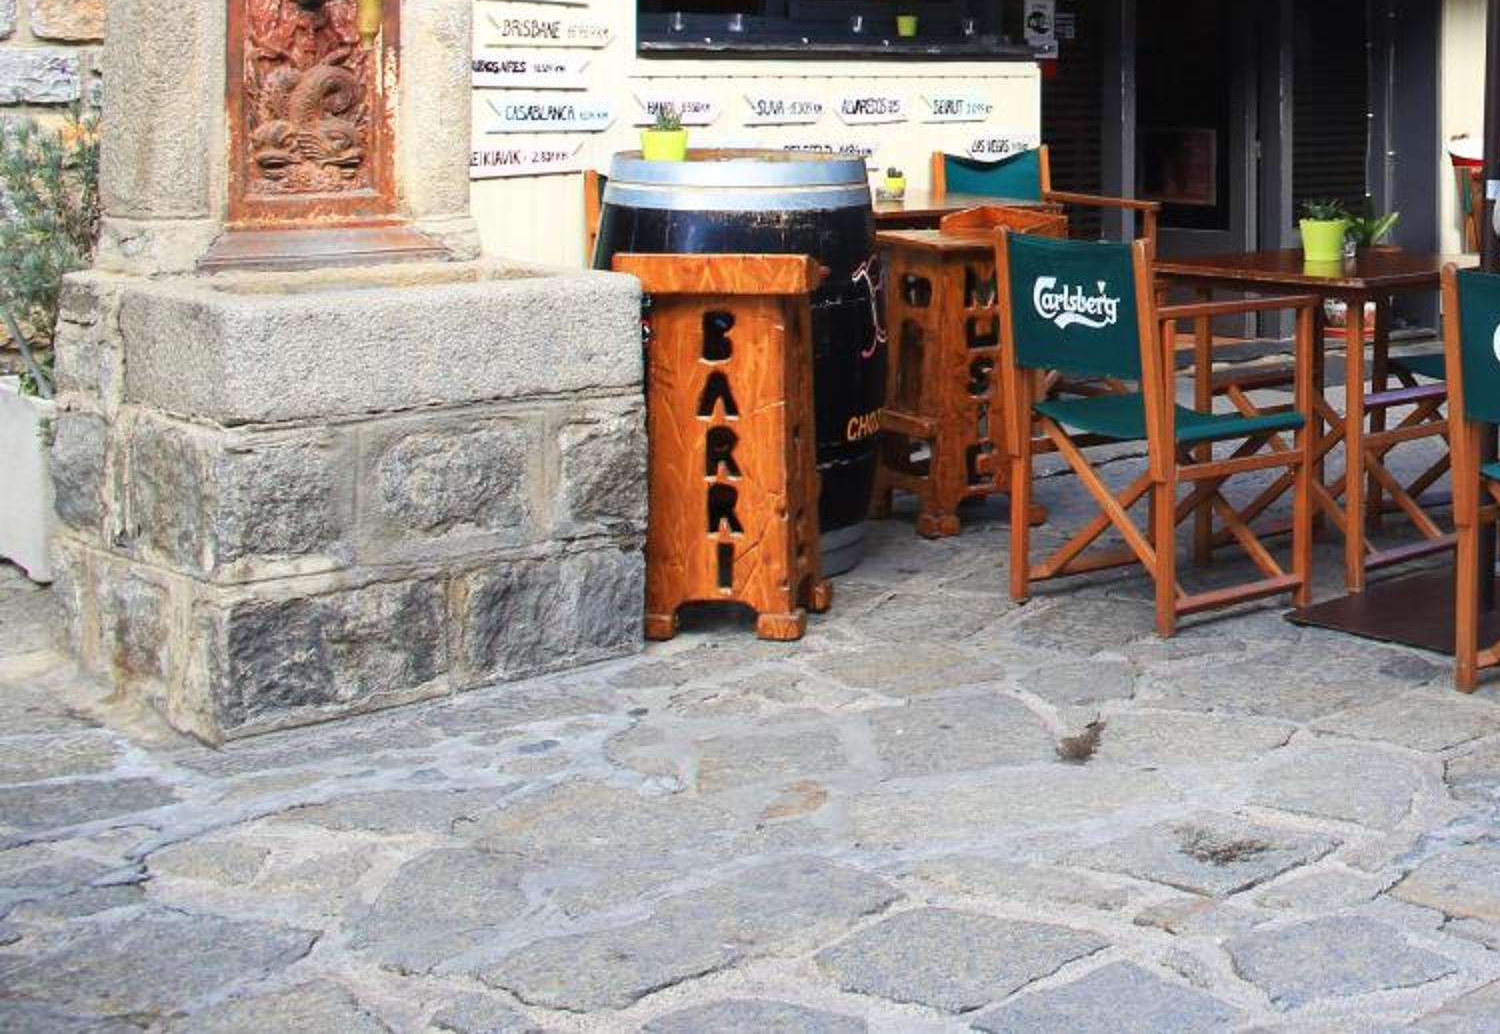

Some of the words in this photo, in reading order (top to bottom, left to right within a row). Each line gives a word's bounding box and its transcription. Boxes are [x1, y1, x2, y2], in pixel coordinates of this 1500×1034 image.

[501, 18, 562, 39] BRISBANE
[505, 105, 576, 122] CASABLANCA
[757, 98, 784, 117] SUVA
[1033, 275, 1121, 330] Carlsberg
[963, 265, 1001, 490] MUSIC
[696, 310, 745, 594] BARRI
